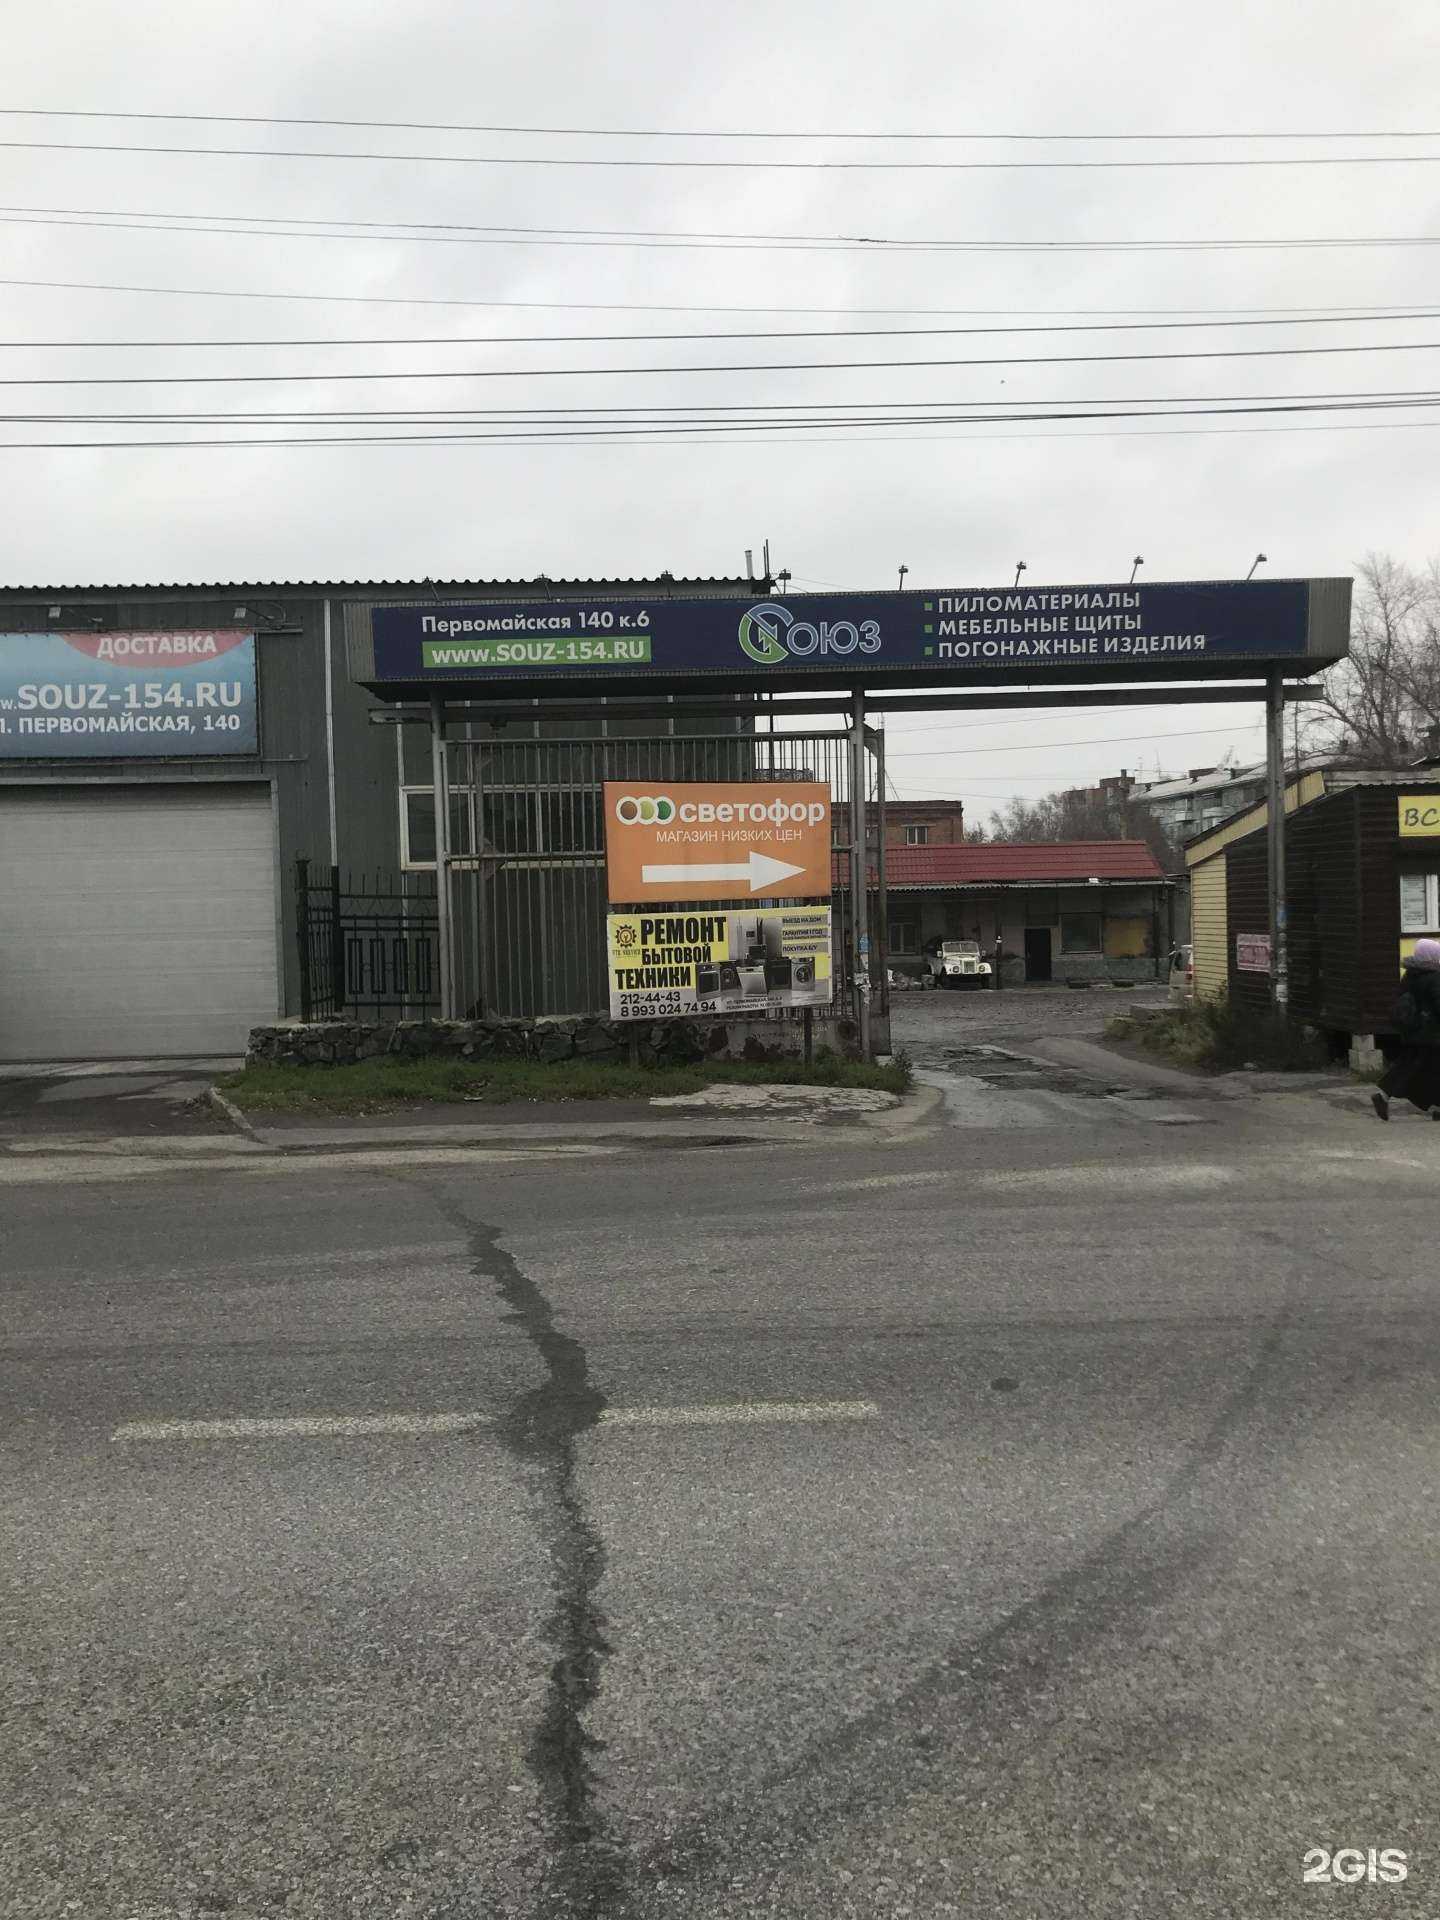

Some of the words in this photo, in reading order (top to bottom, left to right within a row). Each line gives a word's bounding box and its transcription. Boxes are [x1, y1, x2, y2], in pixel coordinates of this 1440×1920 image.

[938, 592, 1140, 613] ПИЛОМАТЕРИАЛЫ
[422, 615, 571, 636] Первомайская
[578, 611, 613, 628] 140
[619, 610, 650, 628] к.6
[938, 616, 1069, 636] МЕБЕЛЬНЫЕ
[1074, 614, 1142, 632] ЩИТЫ
[97, 635, 217, 658] ДОСТАВКА
[431, 640, 645, 663] www.SOUZ-154.RU
[938, 638, 1099, 658] ПОГОНАЖНЫЕ
[1103, 634, 1206, 655] ИЗДЕЛИЯ
[19, 712, 196, 734] ПЕРВОМАЙСКАЯ,
[203, 714, 241, 731] 140
[679, 798, 826, 827] светофор
[656, 830, 718, 843] МАГАЗИН
[721, 830, 772, 841] НИЗКИХ
[776, 829, 802, 842] ЦЕН
[640, 916, 727, 945] РЕМОНТ
[641, 943, 712, 966] БЫТОВОЙ
[614, 965, 691, 990] ТЕХНИКИ
[620, 991, 681, 1005] 212-44-43
[621, 1006, 629, 1017] 8
[631, 1004, 656, 1016] 993
[658, 1003, 682, 1015] 024
[684, 1002, 699, 1012] 74
[700, 1001, 717, 1012] 94
